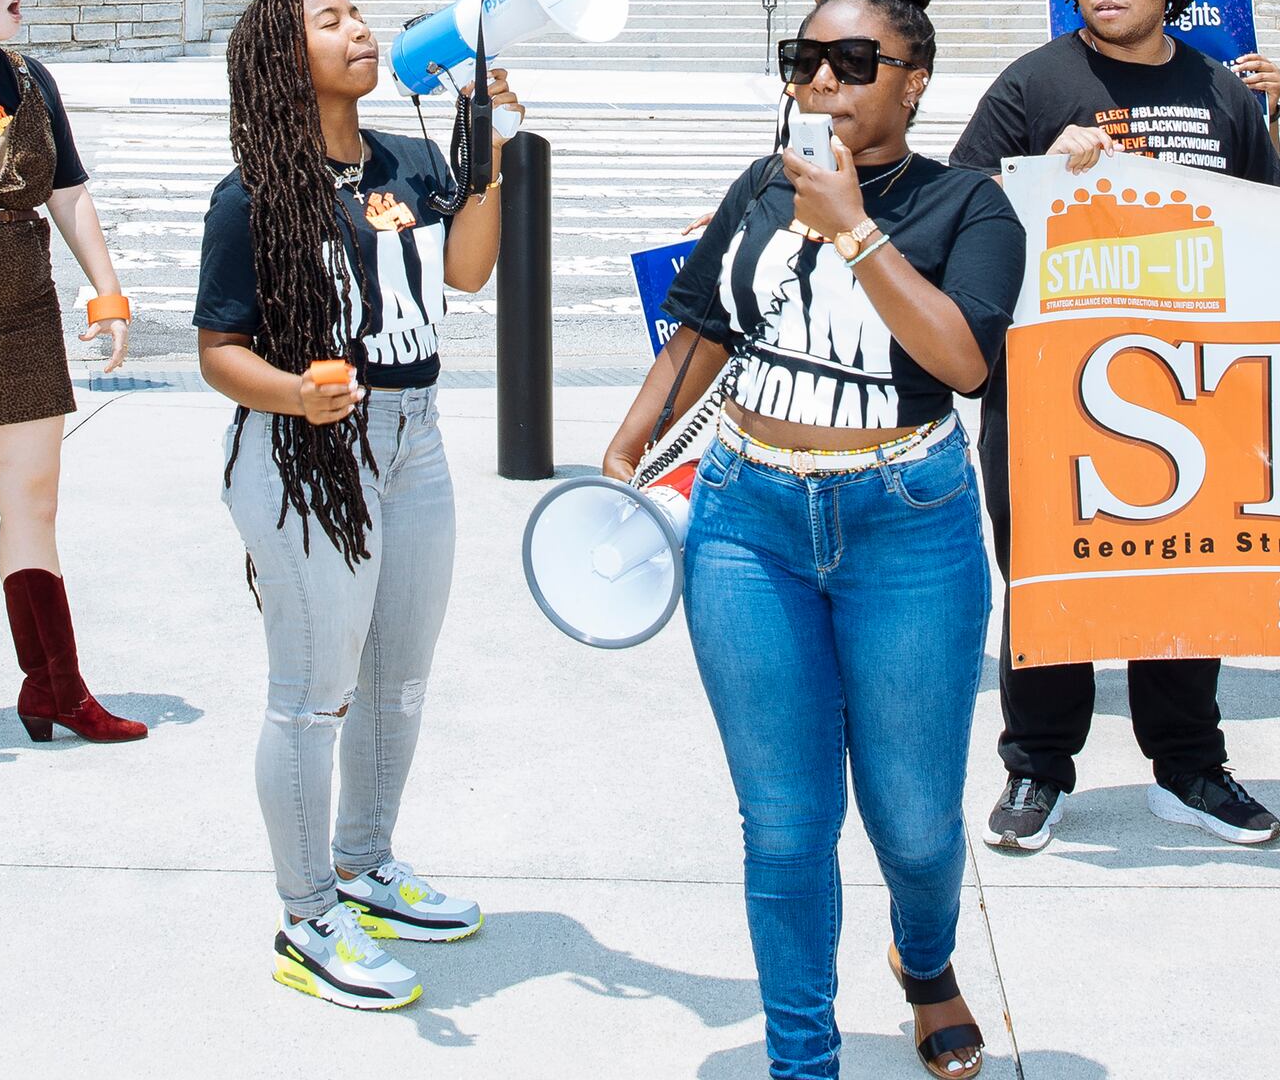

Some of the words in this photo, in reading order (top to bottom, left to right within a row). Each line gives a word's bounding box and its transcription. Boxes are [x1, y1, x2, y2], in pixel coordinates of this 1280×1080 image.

[1095, 108, 1129, 124] ELECT
[1131, 106, 1211, 120] #BLACKWOMEN
[1130, 120, 1209, 135] #BLACKWOMEN
[1148, 135, 1220, 152] #BLACKWOMEN
[1158, 152, 1227, 169] #BLACKWOMEN
[1046, 299, 1073, 310] STRATEGIC
[1074, 297, 1101, 307] ALLIANCE
[1101, 297, 1113, 305] FOR
[1113, 297, 1127, 305] NEW
[1127, 298, 1159, 307] DIRECTIONS
[1160, 300, 1172, 308] AND
[1173, 301, 1194, 310] UNIFIED
[1195, 301, 1220, 310] POLICIES
[734, 353, 900, 429] WOMAN
[1072, 531, 1215, 561] Georgia
